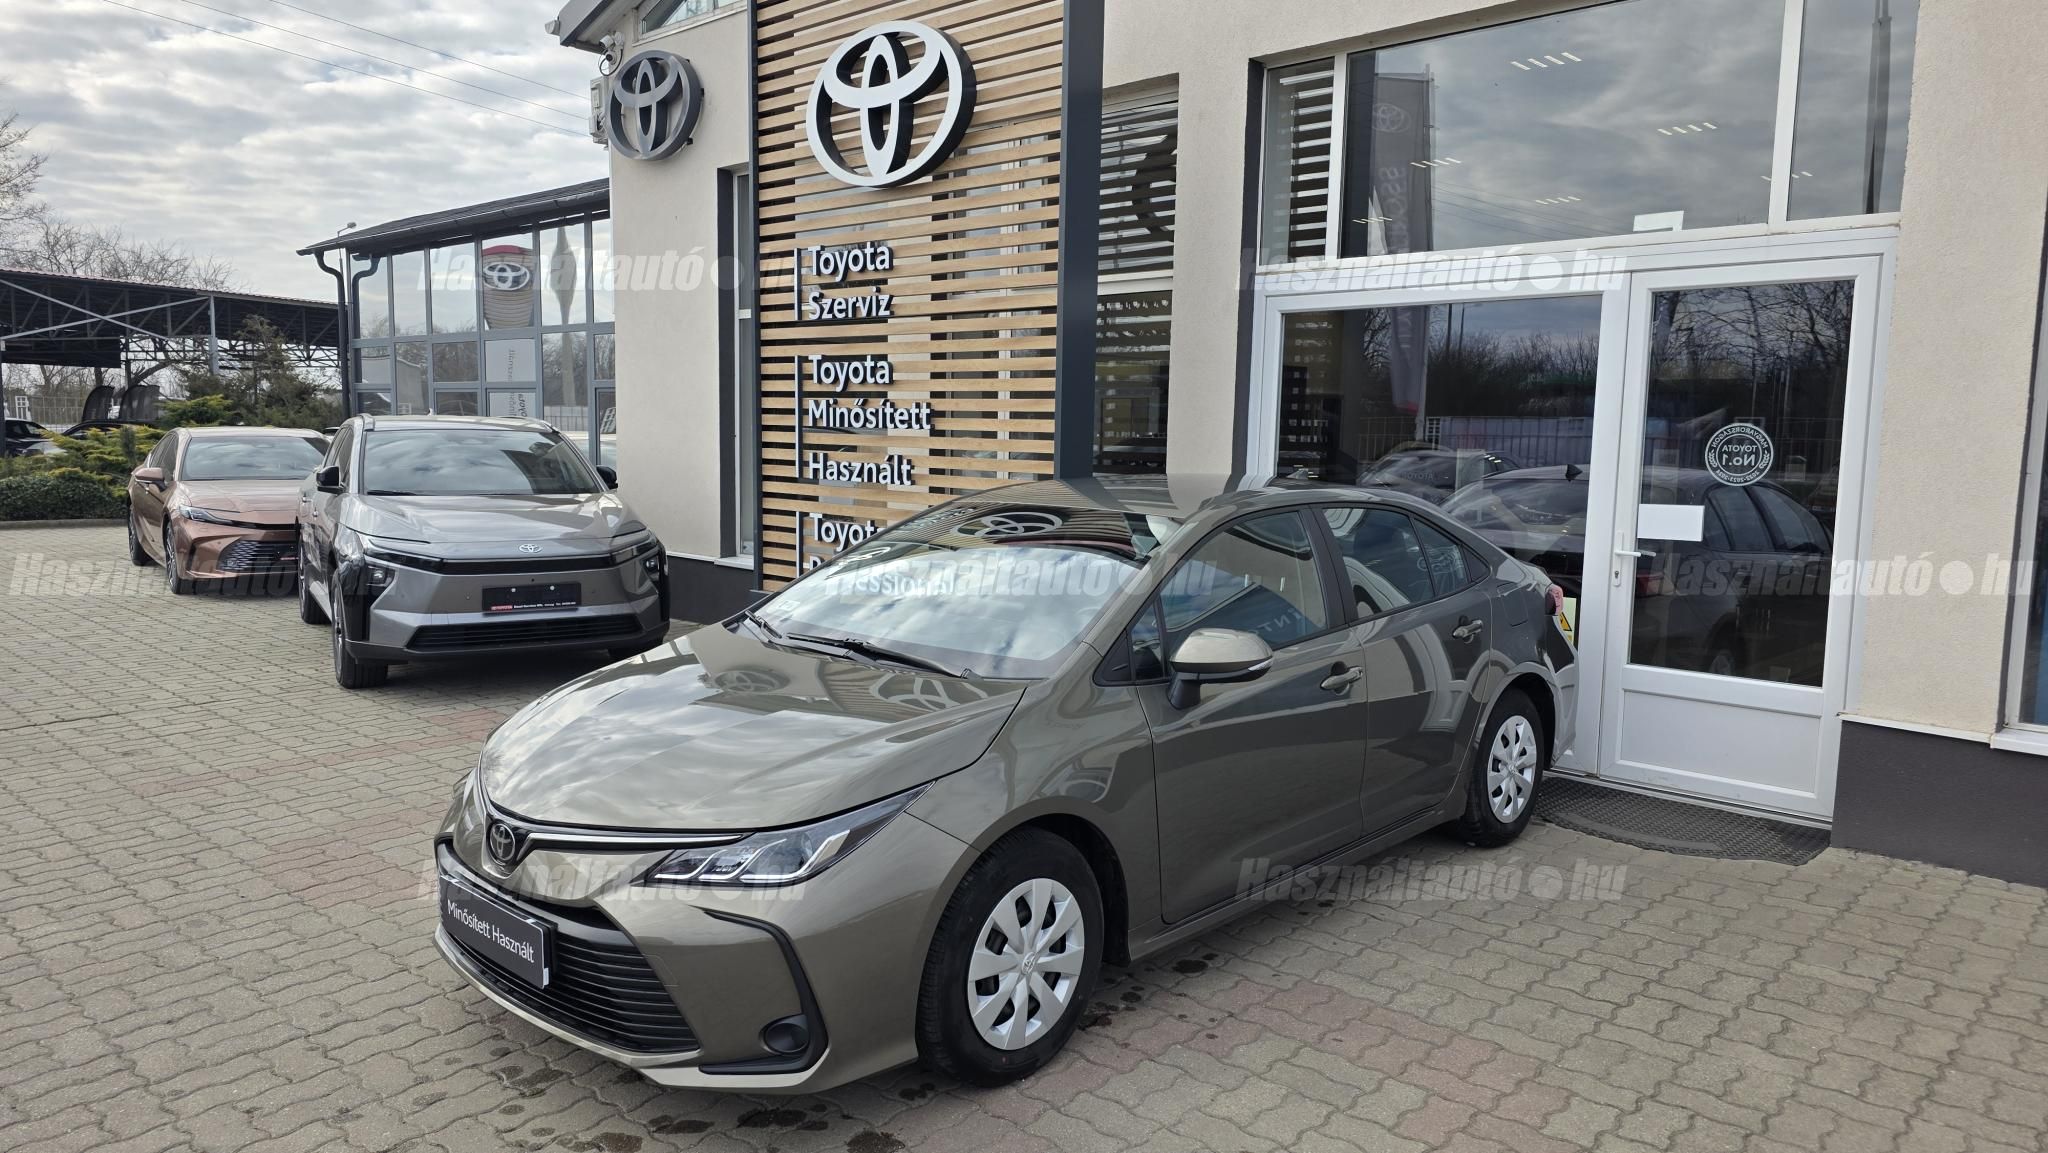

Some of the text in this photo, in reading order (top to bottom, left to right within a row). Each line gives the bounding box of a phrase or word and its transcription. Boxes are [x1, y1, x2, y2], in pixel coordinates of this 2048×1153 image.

[808, 242, 892, 282] Toyota
[808, 286, 892, 320] Szerviz
[808, 355, 892, 392] Toyota
[808, 398, 932, 430] Minősített
[808, 452, 912, 486] Használt
[809, 513, 886, 551] Toyot
[447, 899, 535, 963] Minősített Használt
